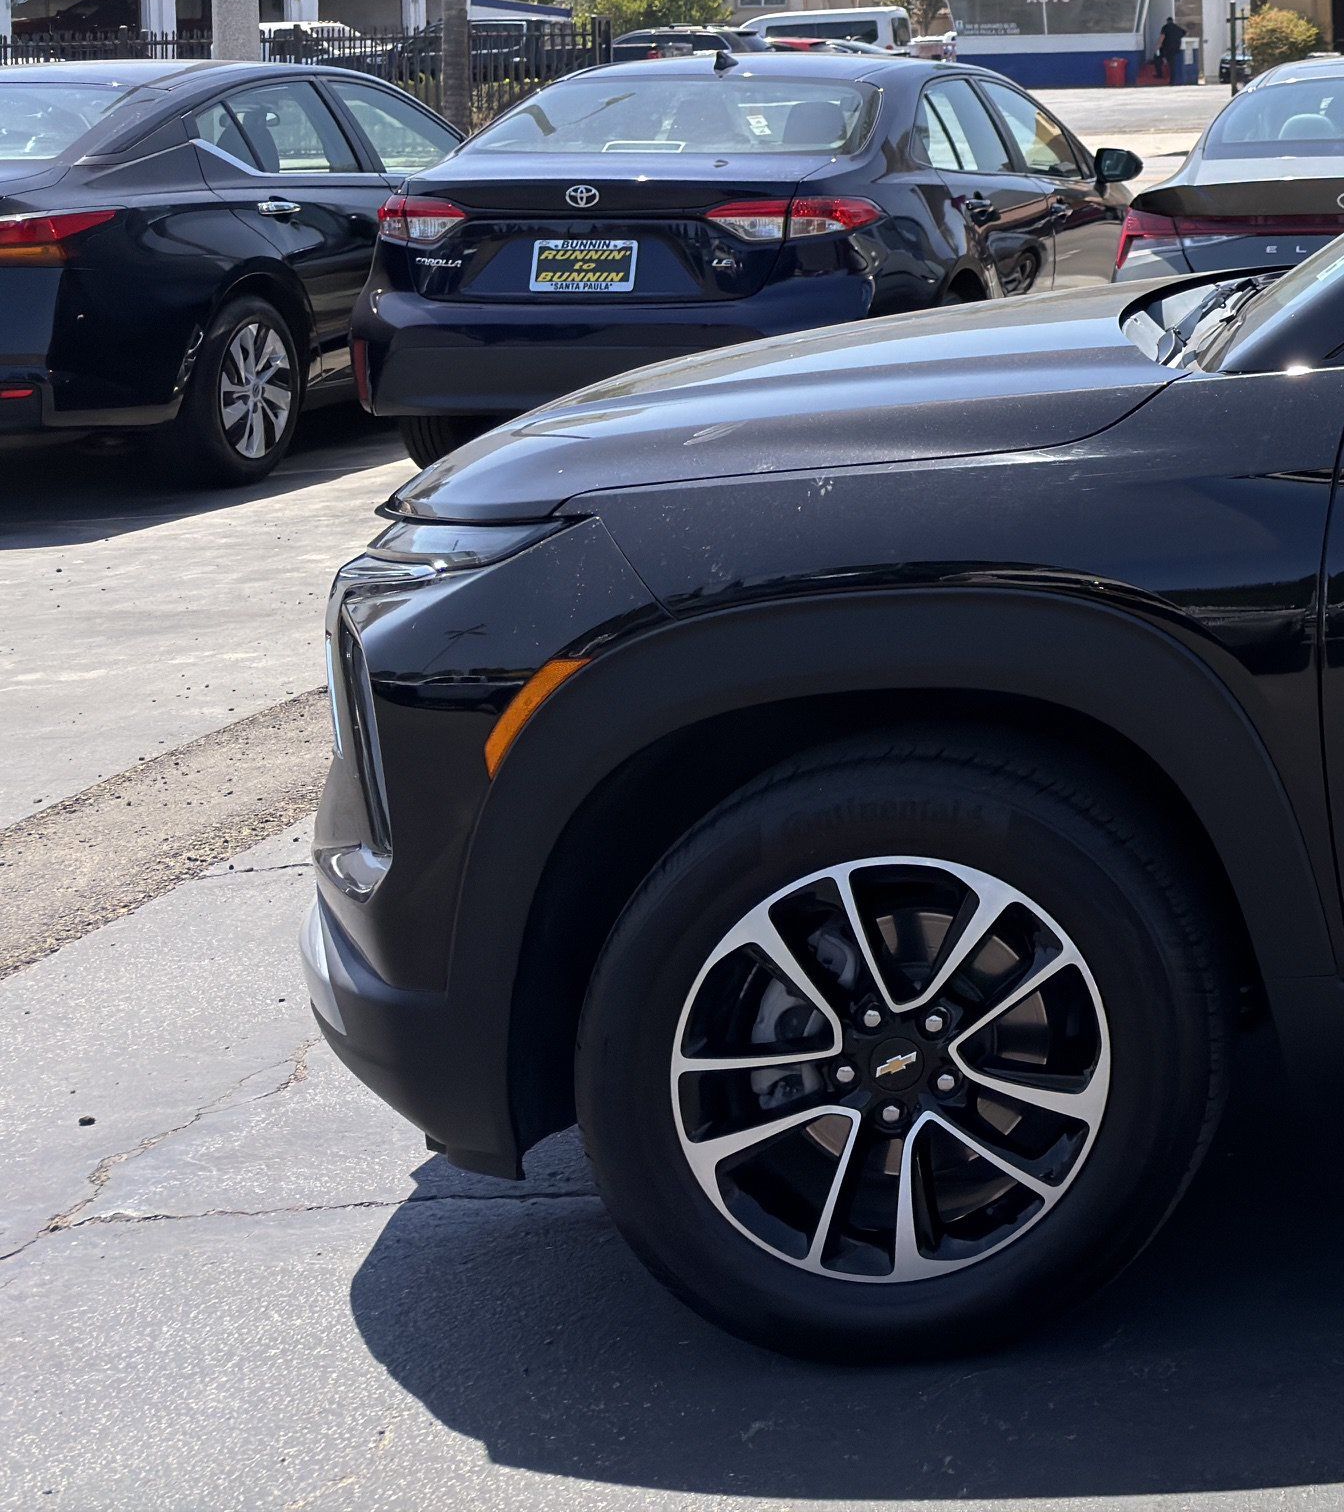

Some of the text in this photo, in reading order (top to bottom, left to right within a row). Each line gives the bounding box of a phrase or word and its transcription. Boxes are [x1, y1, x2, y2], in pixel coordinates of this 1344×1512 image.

[561, 240, 610, 248] BUNNIN
[540, 250, 631, 260] RUNNIN'
[415, 257, 462, 267] COROLLA
[573, 261, 596, 270] to
[537, 272, 624, 282] BUNNIN
